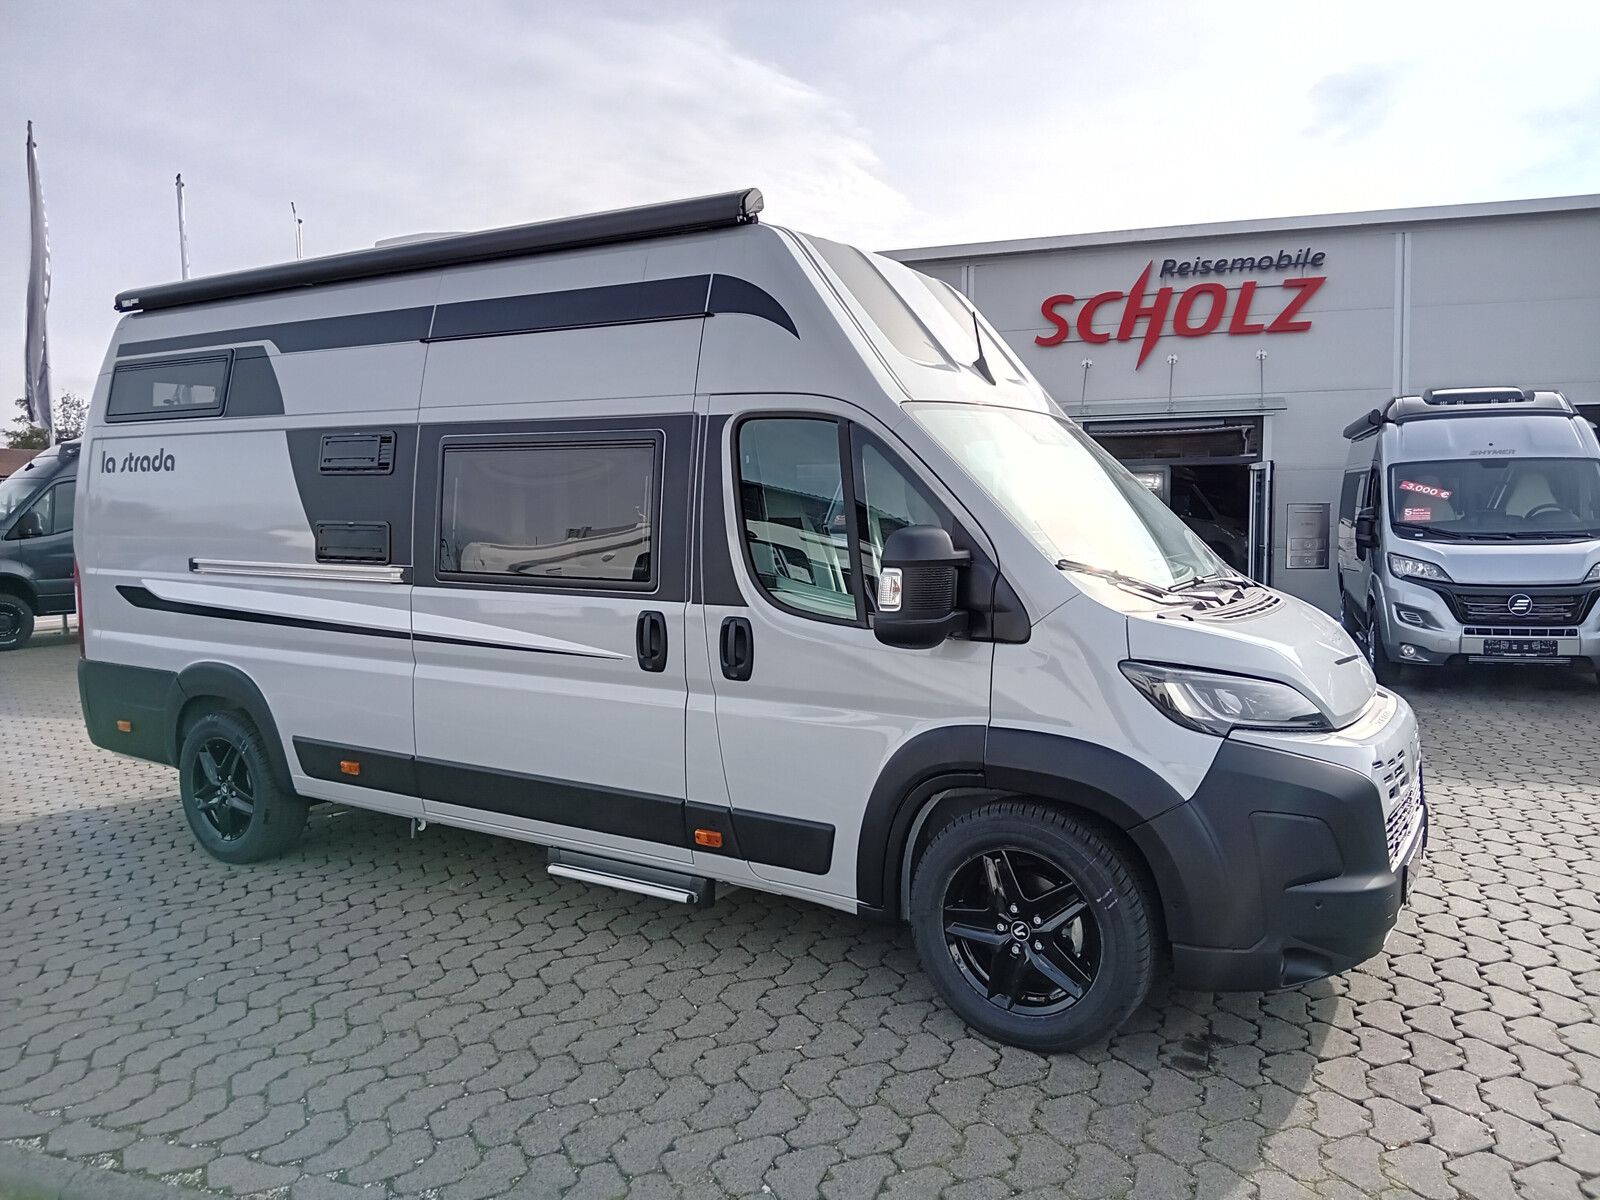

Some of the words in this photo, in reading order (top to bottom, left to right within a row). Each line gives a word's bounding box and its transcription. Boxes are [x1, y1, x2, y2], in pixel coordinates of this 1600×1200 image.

[1160, 248, 1326, 278] Reisemobile
[1034, 260, 1327, 371] SCHOLZ
[101, 450, 116, 473] la
[121, 447, 175, 472] strada
